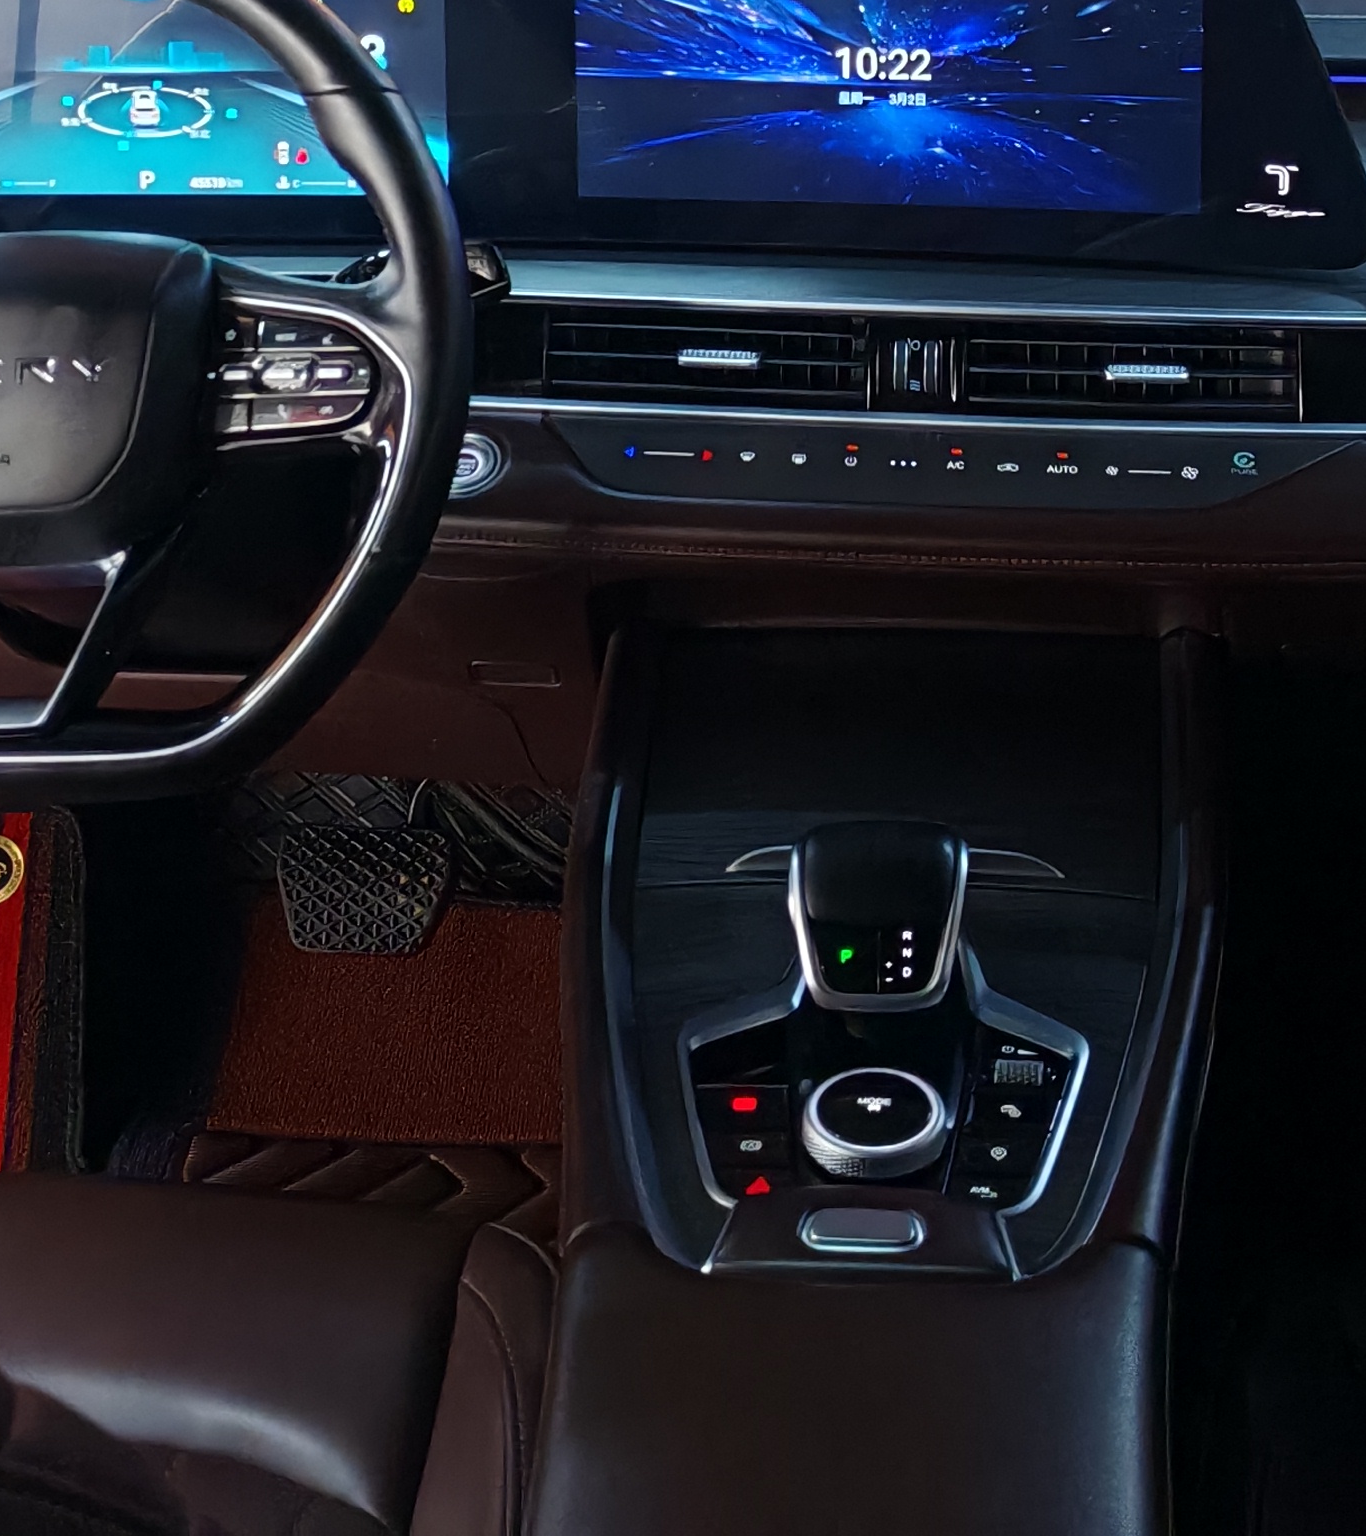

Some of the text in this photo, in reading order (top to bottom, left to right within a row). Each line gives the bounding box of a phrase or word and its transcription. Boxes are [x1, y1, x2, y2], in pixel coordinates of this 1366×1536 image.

[835, 47, 932, 81] 10:22
[888, 92, 927, 107] 3月2日
[139, 170, 156, 190] P
[946, 461, 965, 470] A/C
[1047, 465, 1078, 474] AUTO
[840, 949, 853, 964] P
[902, 948, 913, 958] N
[902, 966, 913, 978] D
[857, 1097, 892, 1107] MODE
